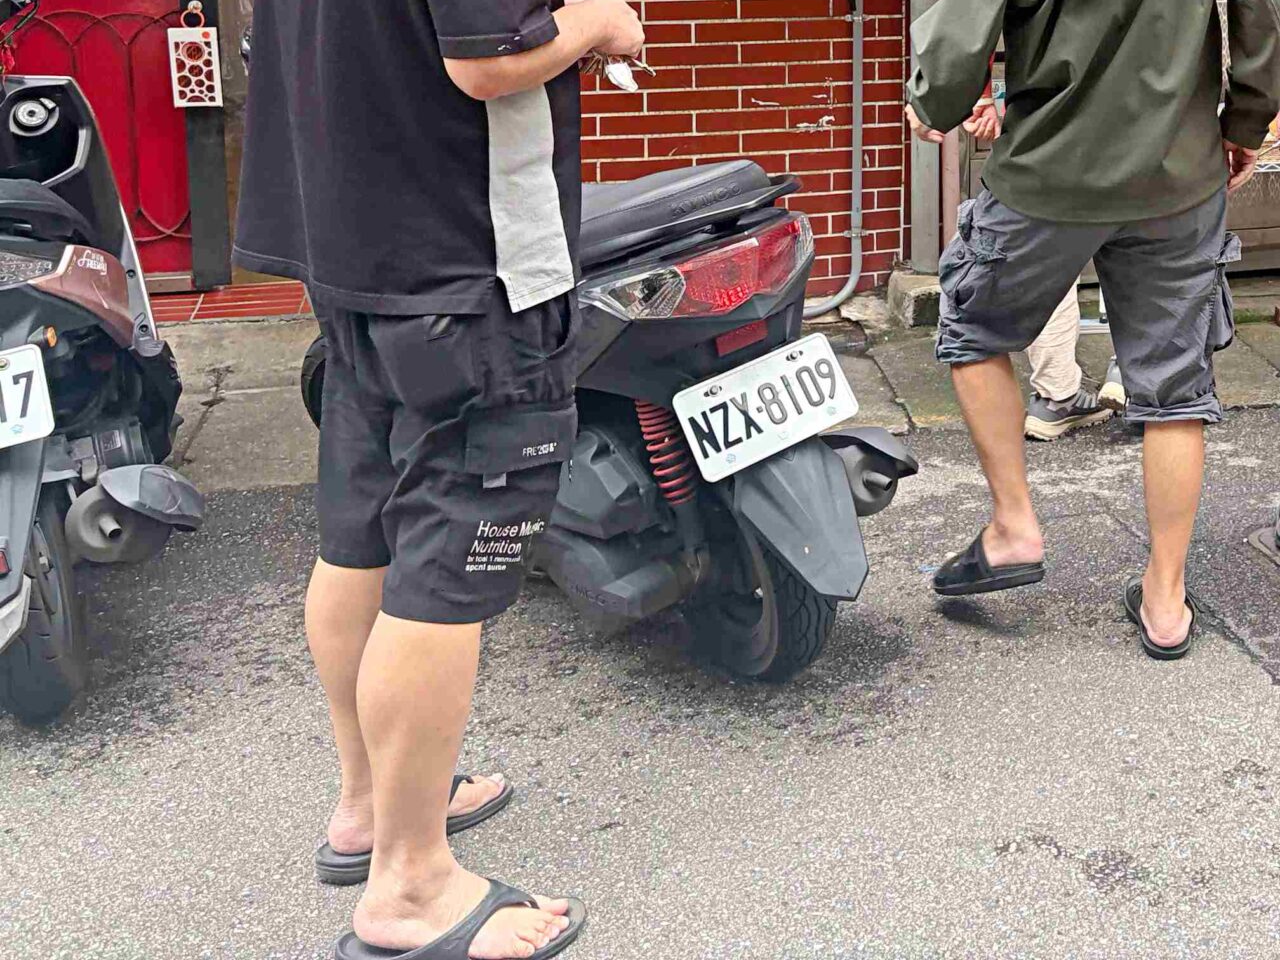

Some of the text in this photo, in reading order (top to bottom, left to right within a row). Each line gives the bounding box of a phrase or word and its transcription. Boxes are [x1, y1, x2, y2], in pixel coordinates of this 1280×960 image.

[687, 357, 837, 460] NZX-8109
[476, 520, 518, 538] House
[469, 539, 522, 555] Nutrition
